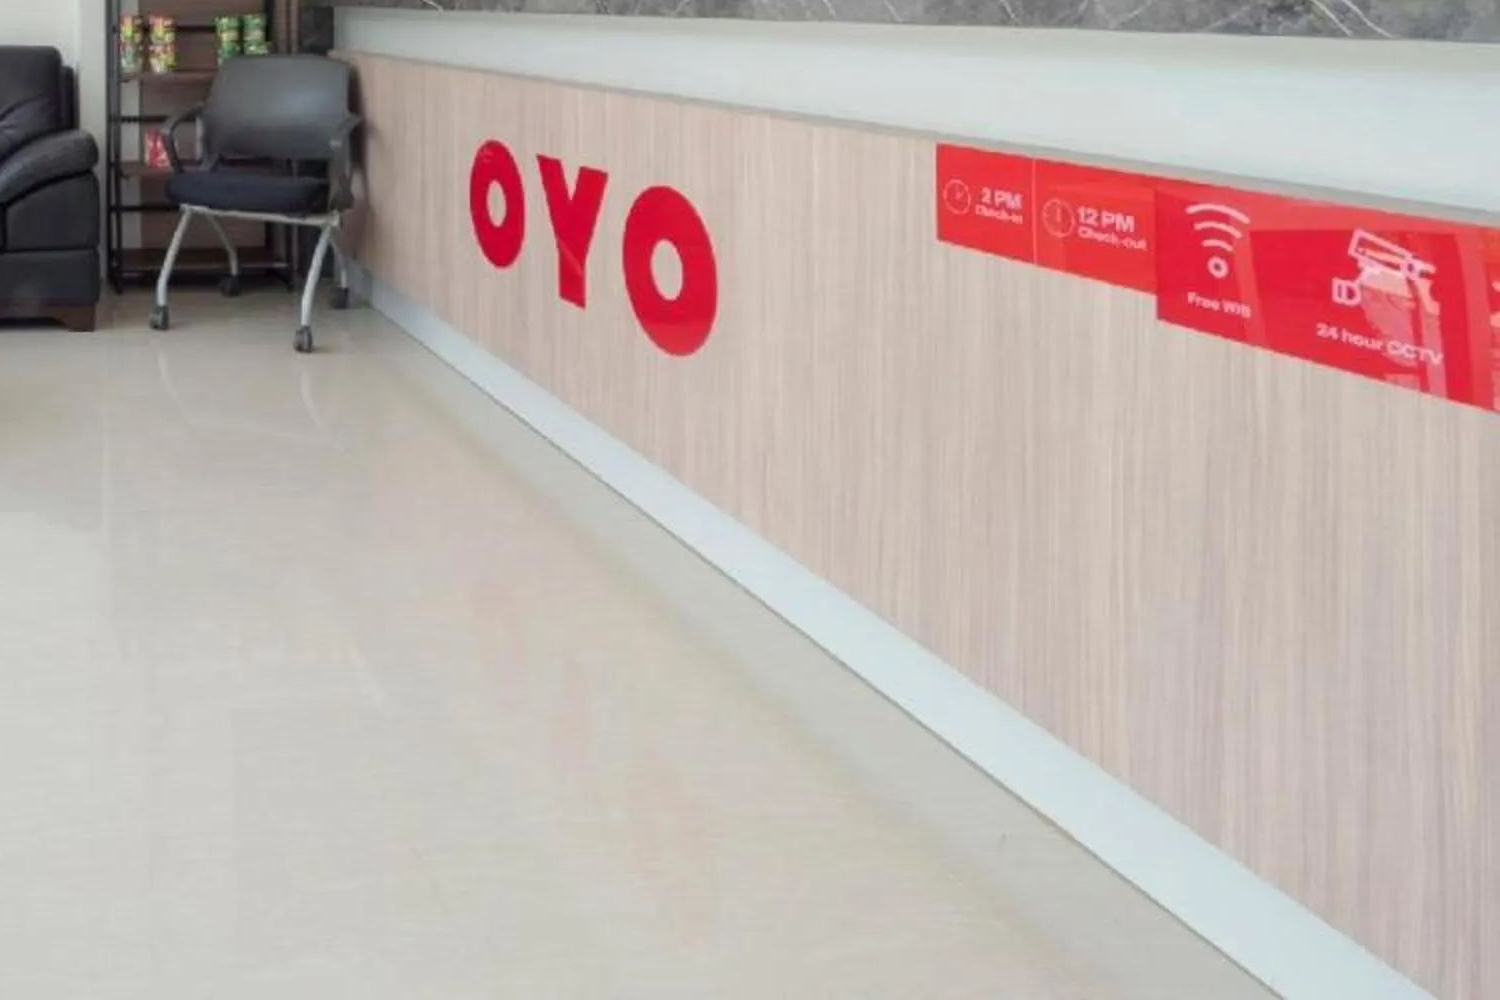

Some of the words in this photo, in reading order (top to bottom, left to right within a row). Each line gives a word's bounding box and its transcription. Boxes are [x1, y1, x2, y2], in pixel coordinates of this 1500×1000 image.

[981, 187, 992, 205] 2
[994, 189, 1023, 210] PM
[1077, 205, 1099, 227] 12
[1101, 210, 1135, 233] PM
[469, 139, 718, 356] OYO
[1187, 291, 1221, 311] Free
[1316, 321, 1338, 340] 24
[1341, 327, 1383, 350] hour
[1386, 340, 1444, 366] CCTV
